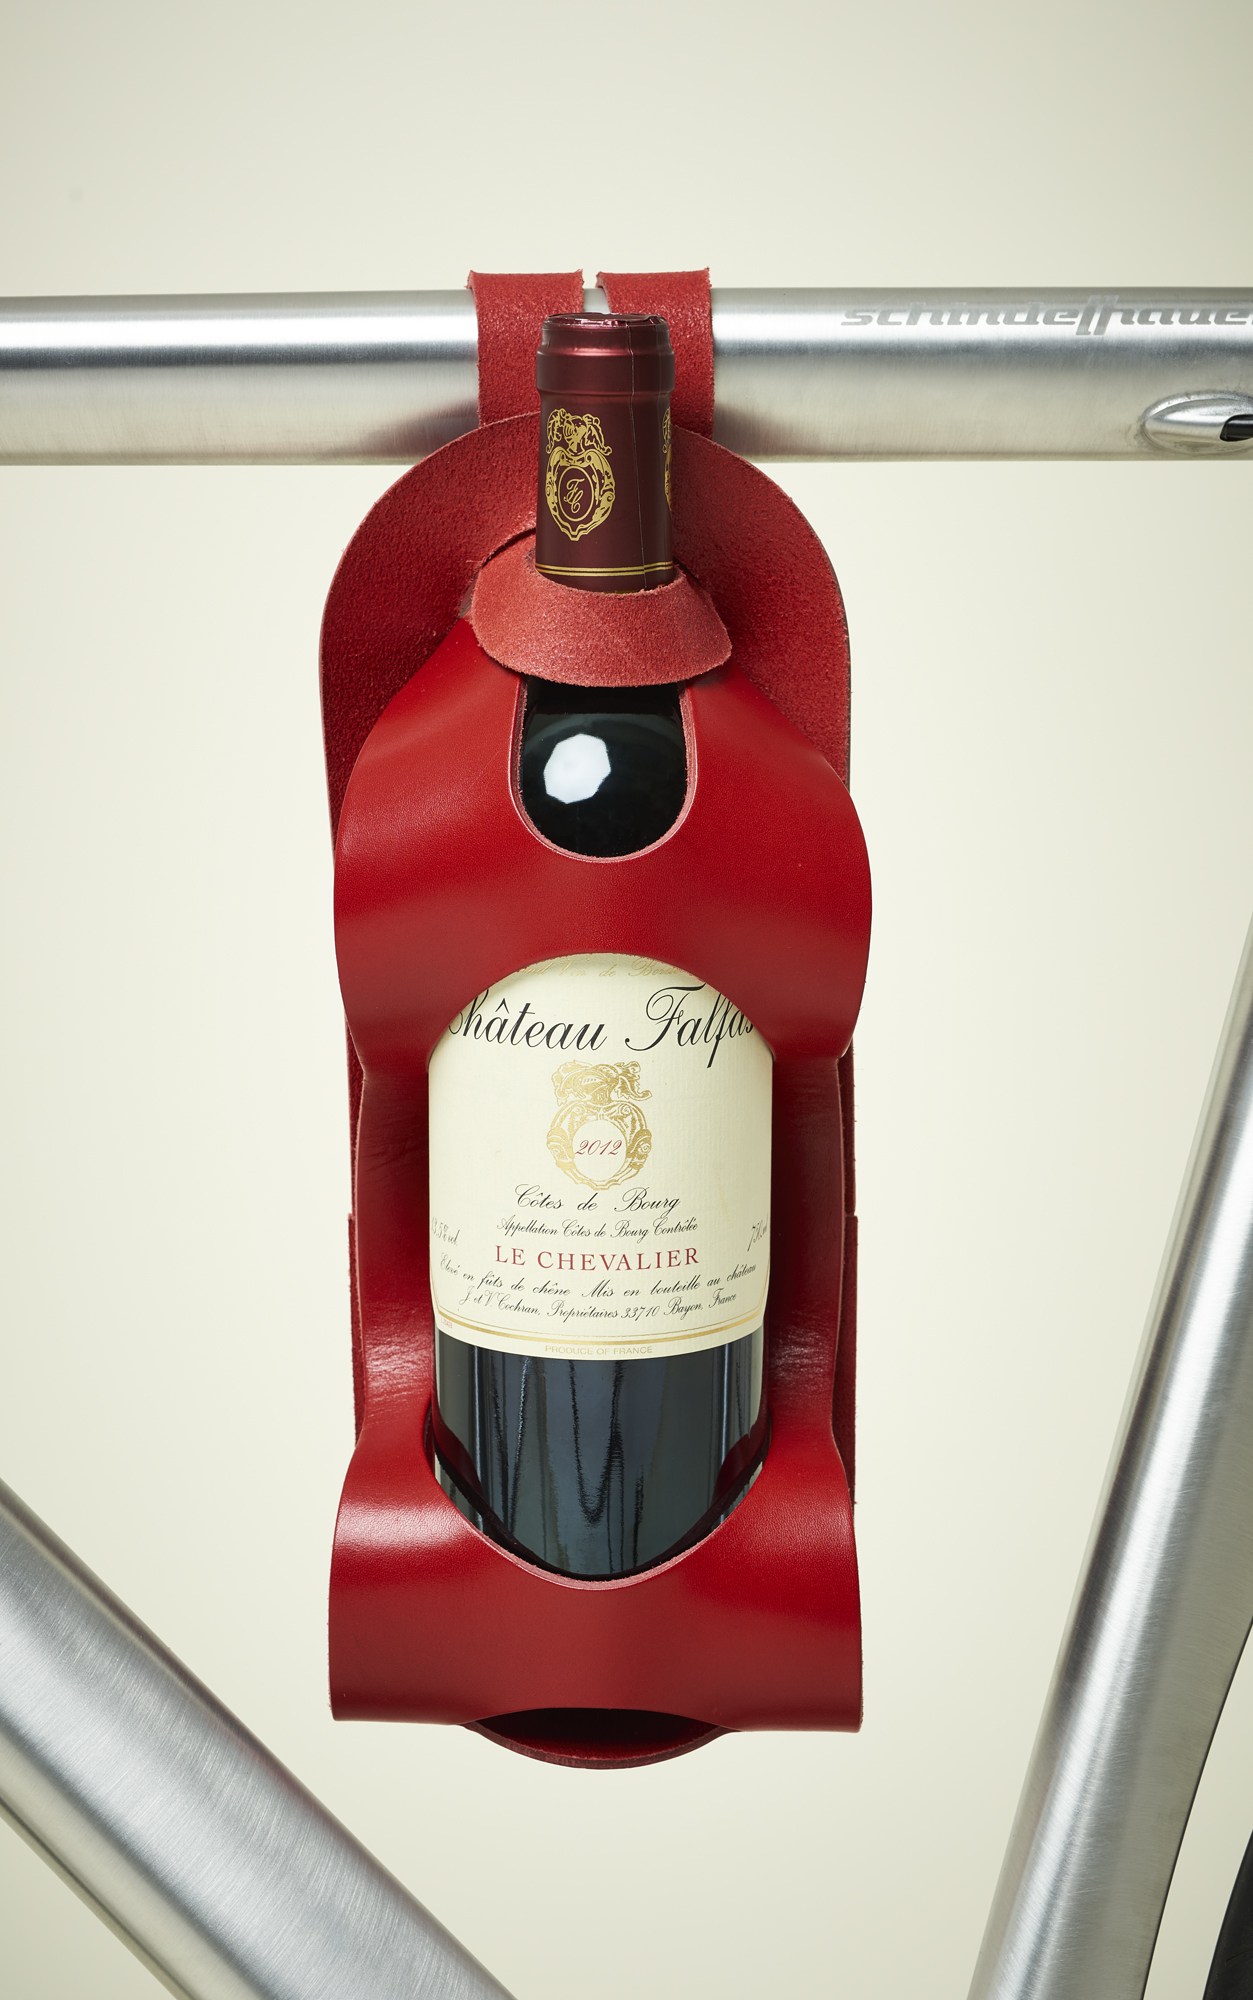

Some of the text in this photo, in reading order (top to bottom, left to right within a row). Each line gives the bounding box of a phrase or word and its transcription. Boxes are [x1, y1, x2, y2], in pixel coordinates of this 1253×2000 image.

[841, 294, 1253, 336] schindelhaue
[449, 988, 608, 1051] hâteau
[575, 1139, 623, 1156] 2012
[514, 1184, 682, 1219] Côtes de Bourg
[496, 1214, 700, 1244] Appellation Côtes de Bourg Contrôlée
[495, 1244, 700, 1272] LE CHEVALIER
[462, 1272, 476, 1282] en
[476, 1270, 504, 1290] fûts
[510, 1277, 526, 1293] de
[532, 1279, 572, 1297] chêne
[581, 1279, 615, 1298] Mis
[623, 1288, 641, 1298] en
[650, 1274, 701, 1297] bouteille
[706, 1277, 721, 1287] au
[726, 1263, 757, 1282] château
[473, 1294, 484, 1305] et
[546, 1299, 619, 1324] Propriétaires
[620, 1305, 661, 1322] 33710
[663, 1296, 704, 1320] Bayon,
[708, 1287, 737, 1309] France
[544, 1344, 653, 1356] PRODUCE OF FRANCE
